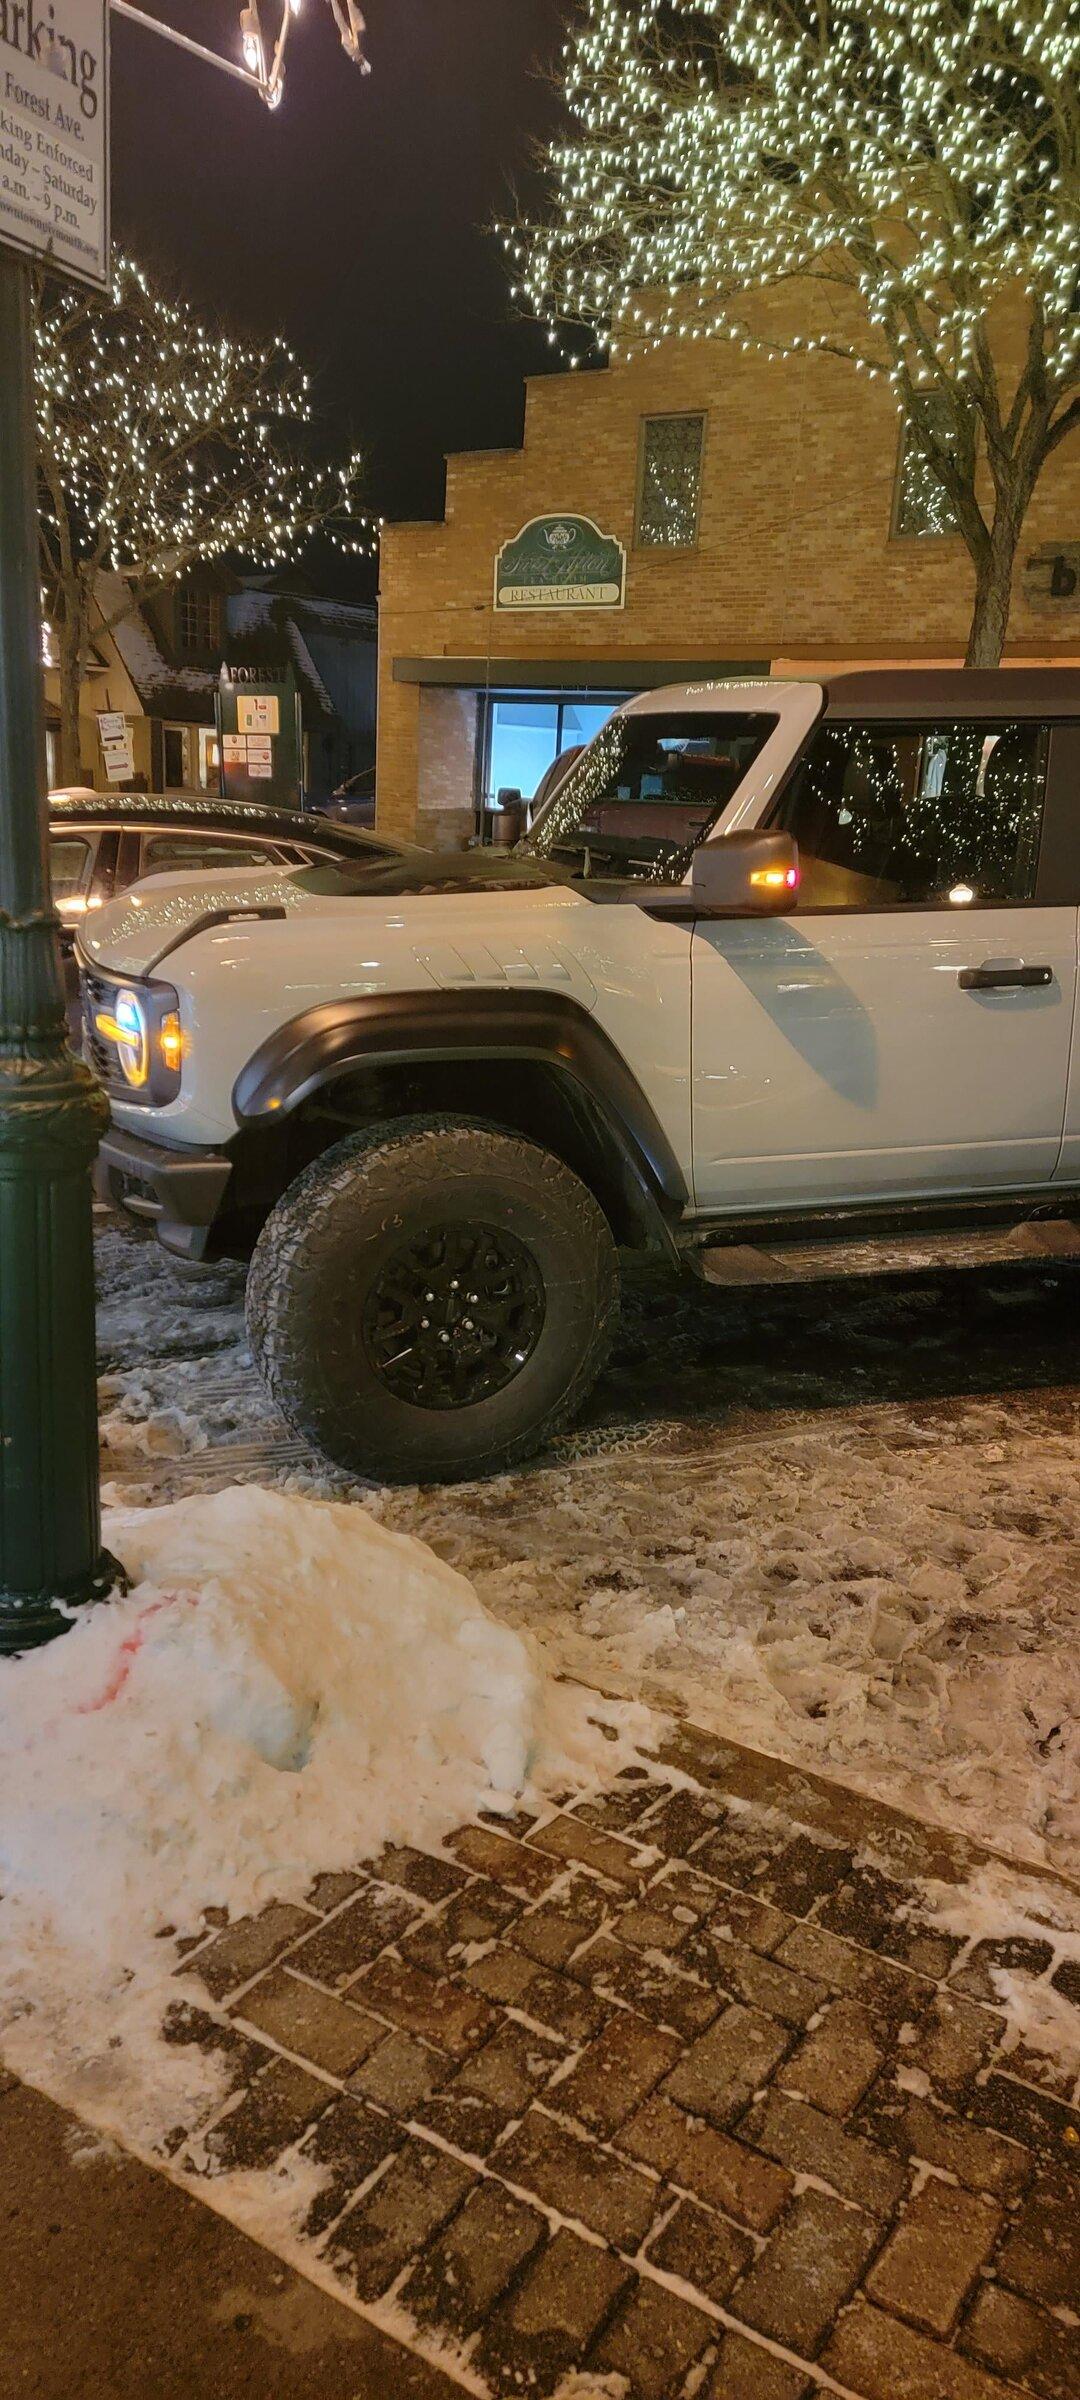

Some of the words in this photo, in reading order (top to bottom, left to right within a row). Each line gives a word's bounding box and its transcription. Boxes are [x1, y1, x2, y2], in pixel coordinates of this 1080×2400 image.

[6, 71, 50, 121] Forest
[55, 104, 85, 141] Ave.
[37, 131, 93, 182] Enforced
[2, 174, 30, 201] a.m.
[44, 192, 51, 210] 9
[54, 204, 80, 229] p.m.
[43, 165, 97, 216] Saturday
[510, 586, 608, 602] RESTAURANT
[229, 666, 283, 684] FOREST
